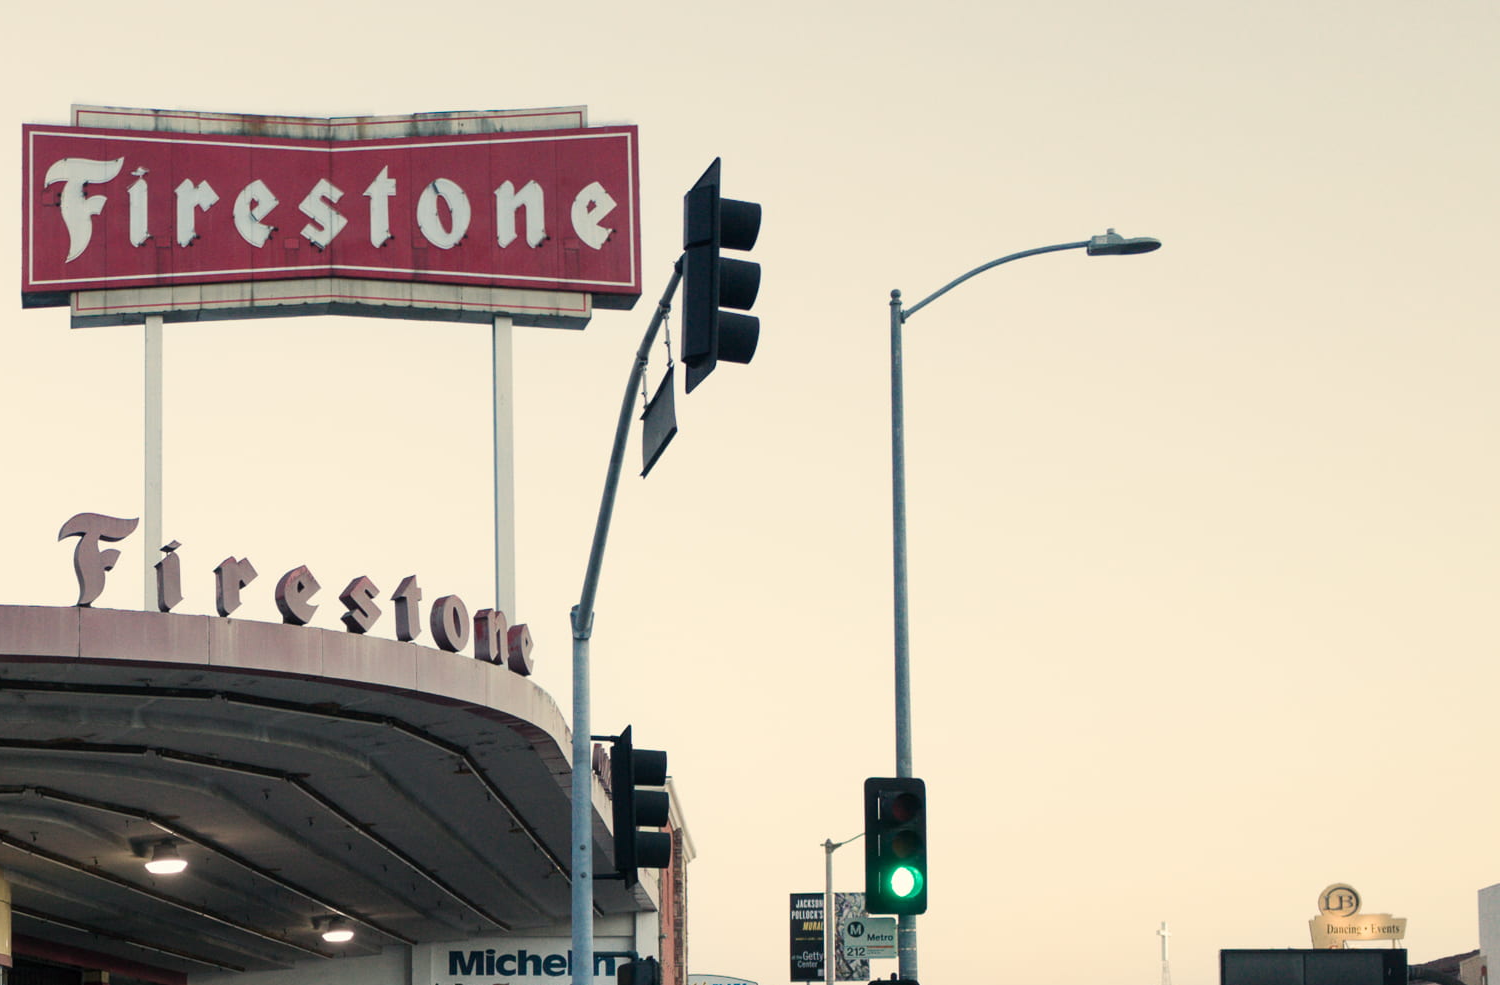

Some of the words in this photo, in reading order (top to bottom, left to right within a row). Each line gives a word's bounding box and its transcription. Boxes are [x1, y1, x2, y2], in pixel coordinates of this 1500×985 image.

[44, 156, 618, 264] Firestone
[58, 512, 535, 676] Firestone
[796, 900, 824, 908] JACKSON
[792, 910, 824, 920] POLLOCK'S
[1327, 924, 1361, 936] Dancing
[1371, 924, 1400, 934] Events
[867, 934, 894, 942] Metro
[803, 951, 824, 962] Getty
[847, 947, 866, 957] 212
[449, 949, 615, 976] Micheln
[797, 960, 819, 968] Center
